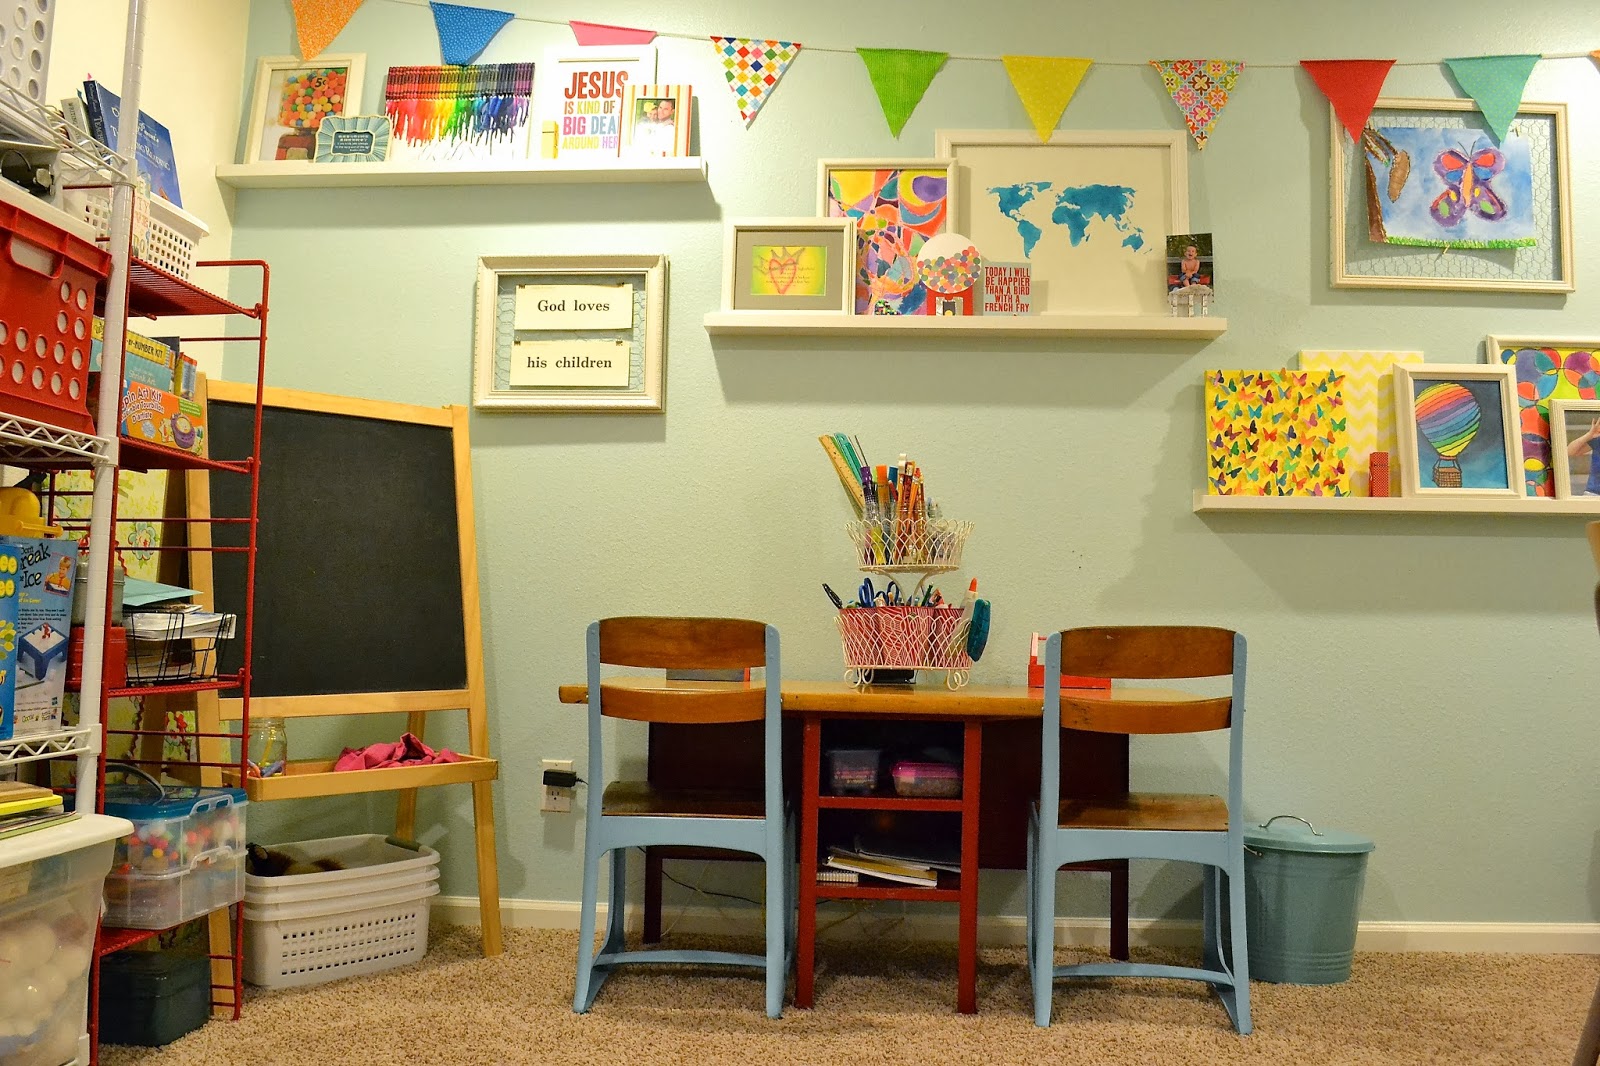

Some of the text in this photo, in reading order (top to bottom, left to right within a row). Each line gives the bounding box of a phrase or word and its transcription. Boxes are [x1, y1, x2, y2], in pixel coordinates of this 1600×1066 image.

[564, 70, 629, 99] JESUS
[564, 100, 615, 115] IS KIND OF
[563, 115, 620, 136] BIG DEA
[562, 136, 618, 150] AROUND HER
[985, 267, 1007, 277] TODAY
[1014, 267, 1030, 277] WILL
[985, 277, 1030, 286] BE HAPPIER
[985, 286, 1030, 295] THAN A BIRD
[995, 294, 1020, 303] WITH A
[537, 299, 610, 312] God loves
[985, 303, 1030, 312] FRENCH FRY
[155, 348, 163, 358] KIT
[526, 356, 613, 369] his children
[122, 387, 162, 407] pin Art Kit
[20, 542, 51, 570] reak
[23, 570, 42, 588] Ice
